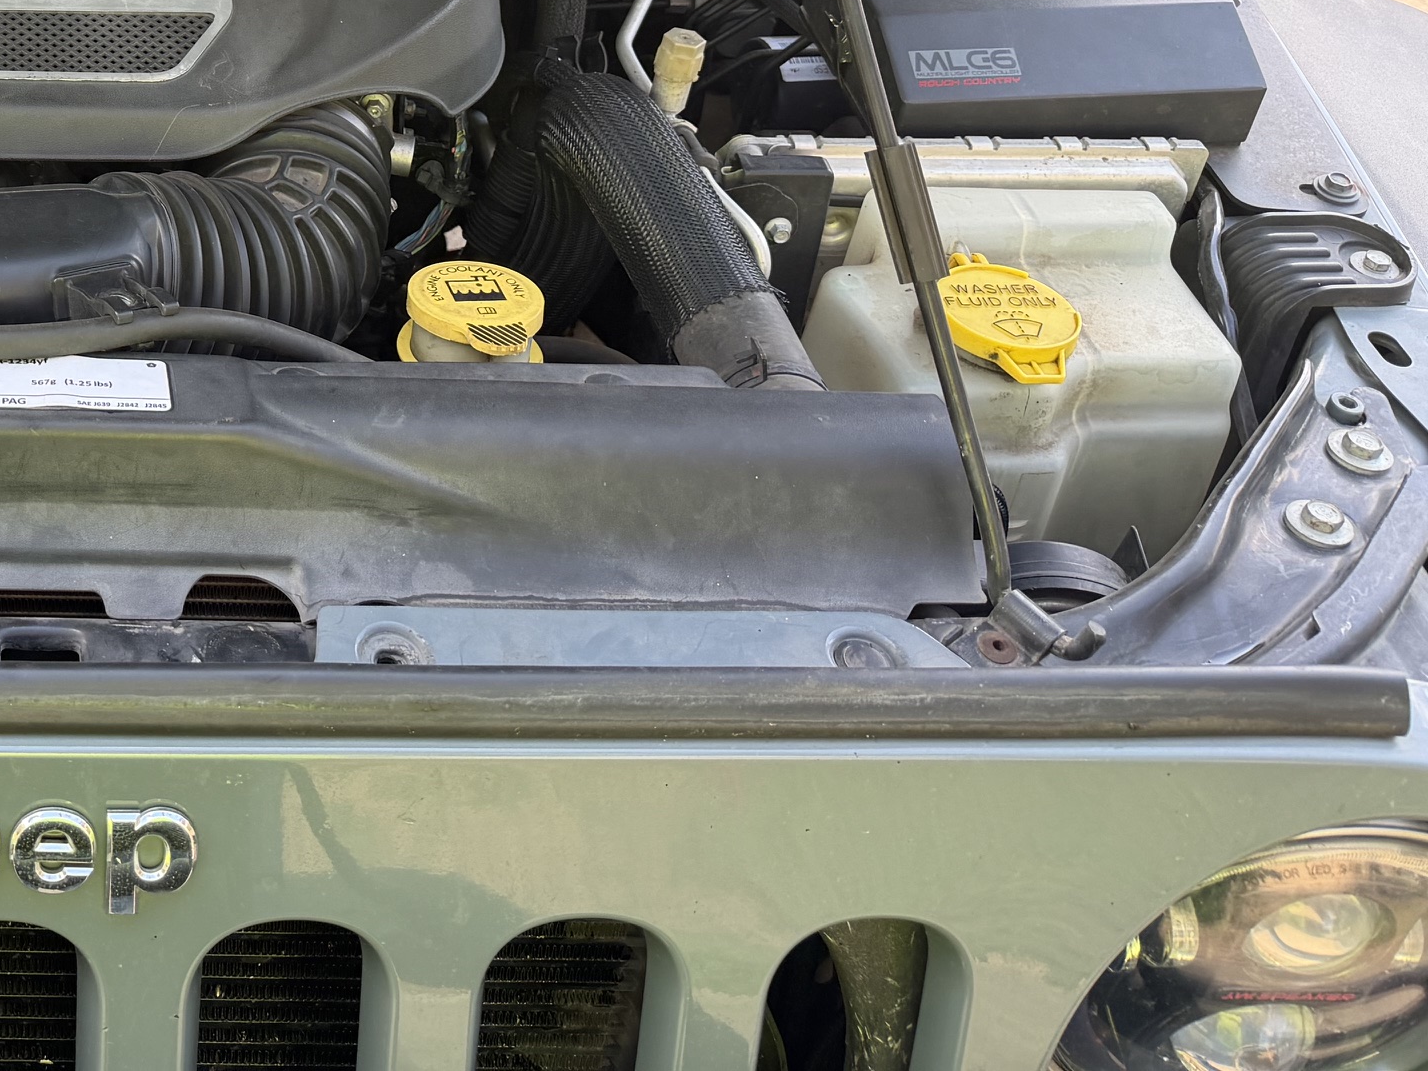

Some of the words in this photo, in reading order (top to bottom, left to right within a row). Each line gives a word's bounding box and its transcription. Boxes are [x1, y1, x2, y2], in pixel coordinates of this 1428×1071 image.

[918, 79, 960, 88] ROUGH
[963, 76, 1021, 86] COUNTRY
[425, 274, 445, 302] ENGINE
[438, 265, 503, 278] COOLANT
[504, 277, 526, 299] ONLY
[951, 283, 1039, 296] WASHER
[943, 296, 1003, 309] FLUID
[1008, 296, 1058, 308] ONLY
[64, 378, 92, 387] (1.25
[93, 380, 113, 389] lbs)
[1, 397, 27, 405] PAG
